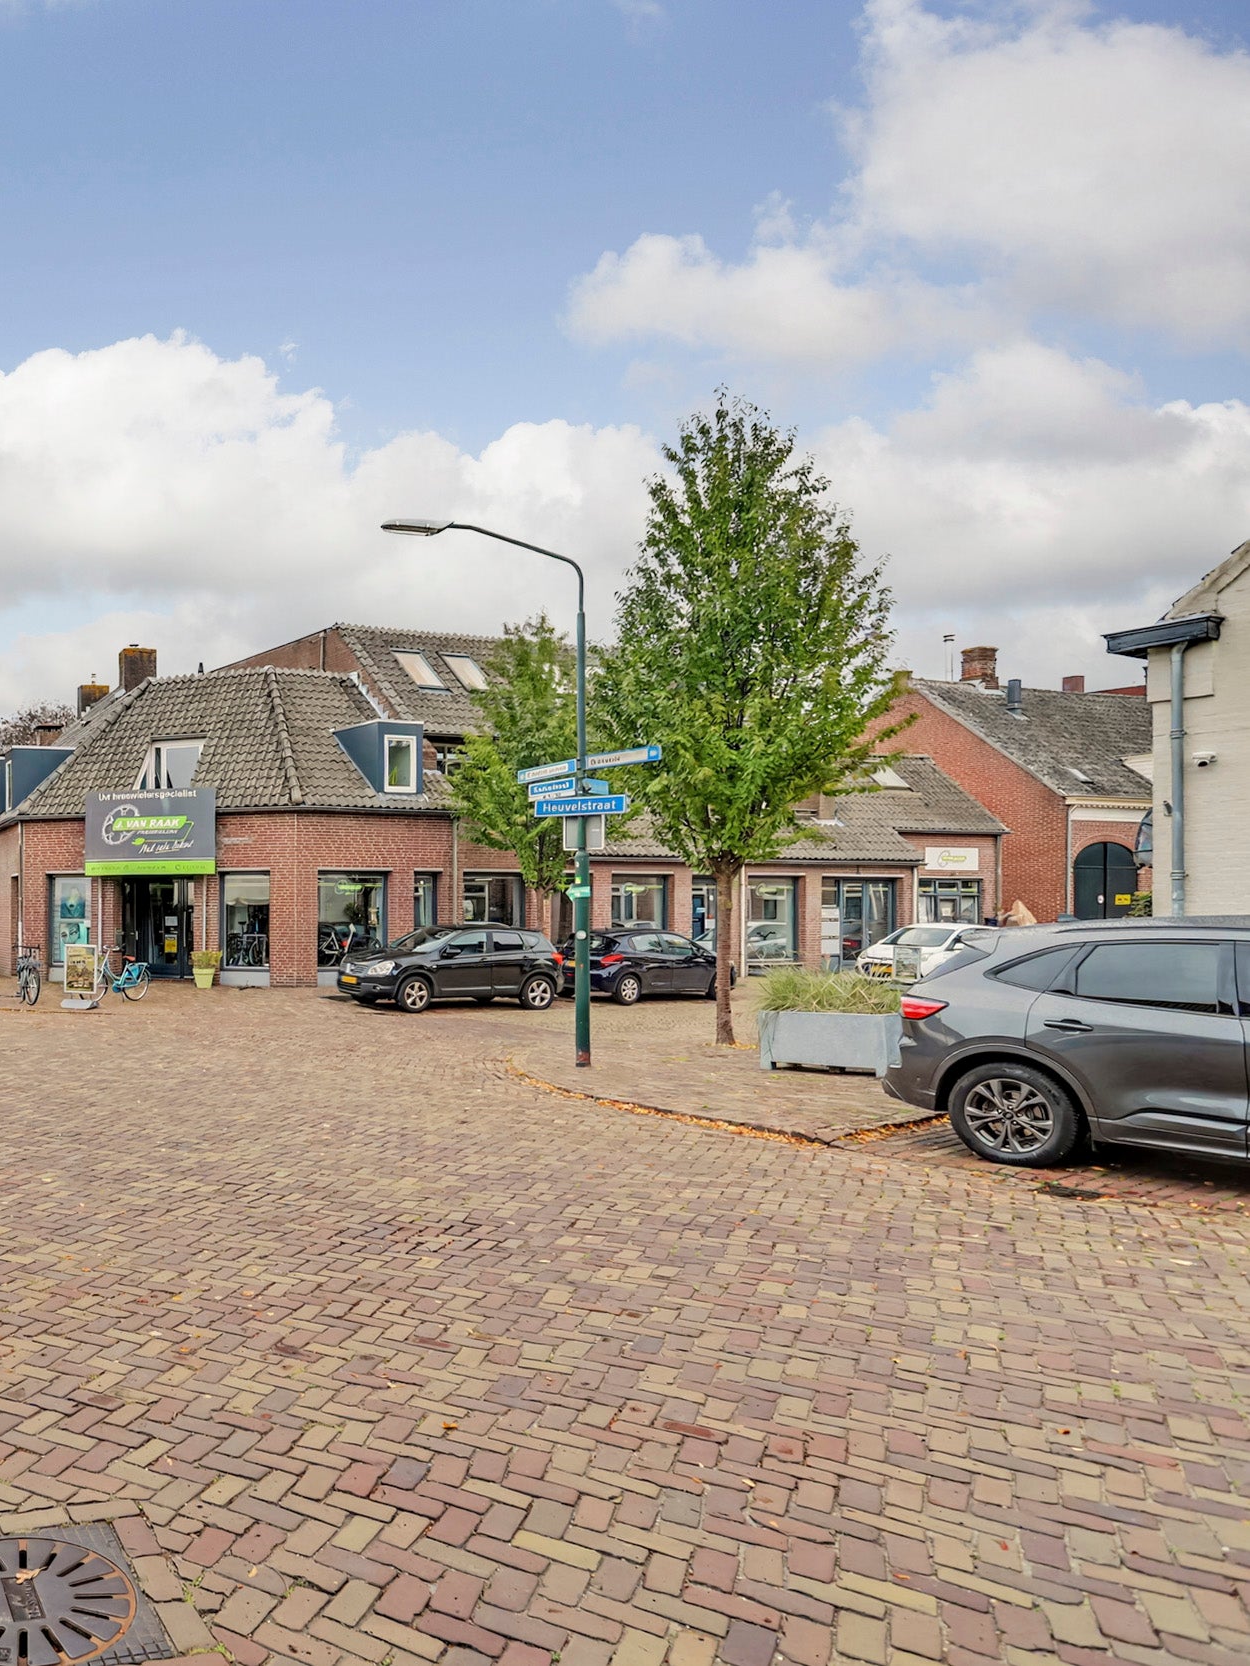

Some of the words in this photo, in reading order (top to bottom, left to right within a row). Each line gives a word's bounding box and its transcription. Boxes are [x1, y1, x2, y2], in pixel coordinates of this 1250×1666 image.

[543, 800, 616, 812] Heuvelstraat
[126, 820, 146, 828] VAN
[149, 819, 180, 828] RAAK
